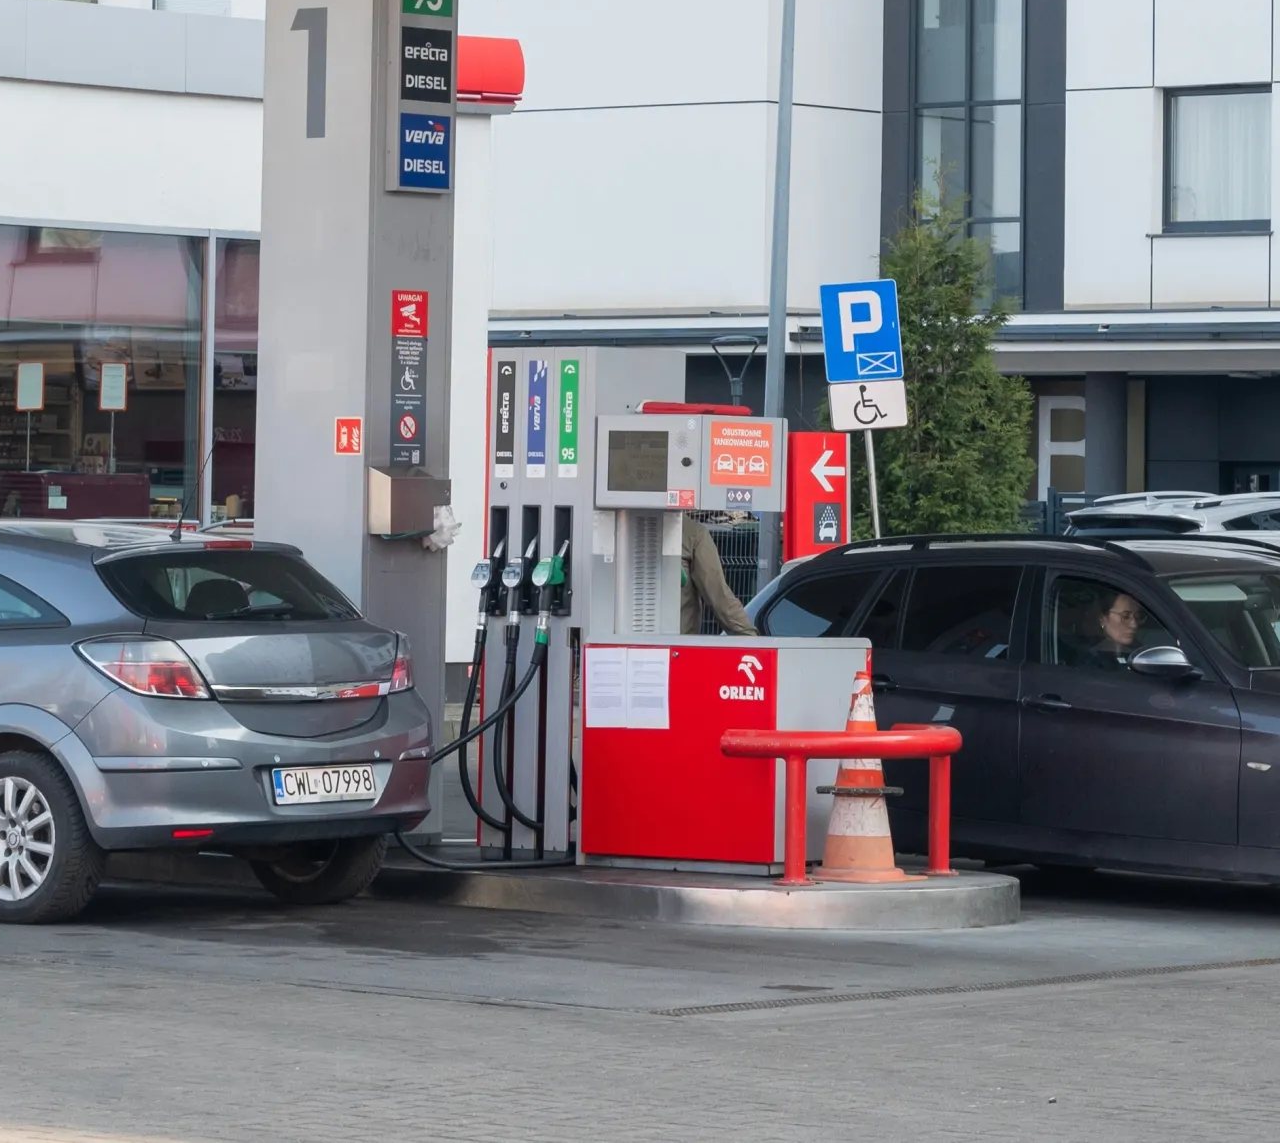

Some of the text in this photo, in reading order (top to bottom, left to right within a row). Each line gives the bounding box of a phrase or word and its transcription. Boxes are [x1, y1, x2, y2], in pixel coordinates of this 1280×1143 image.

[289, 7, 328, 139] 1
[405, 74, 447, 90] DIESEL
[404, 129, 445, 145] verva
[403, 158, 446, 174] DIESEL
[397, 293, 422, 302] UWAGA!
[838, 290, 883, 353] P
[533, 395, 541, 430] verva
[754, 439, 770, 448] AUTA
[561, 447, 575, 460] 95
[719, 684, 765, 701] ORLEN
[284, 772, 318, 796] CWL
[321, 769, 373, 794] 07998
